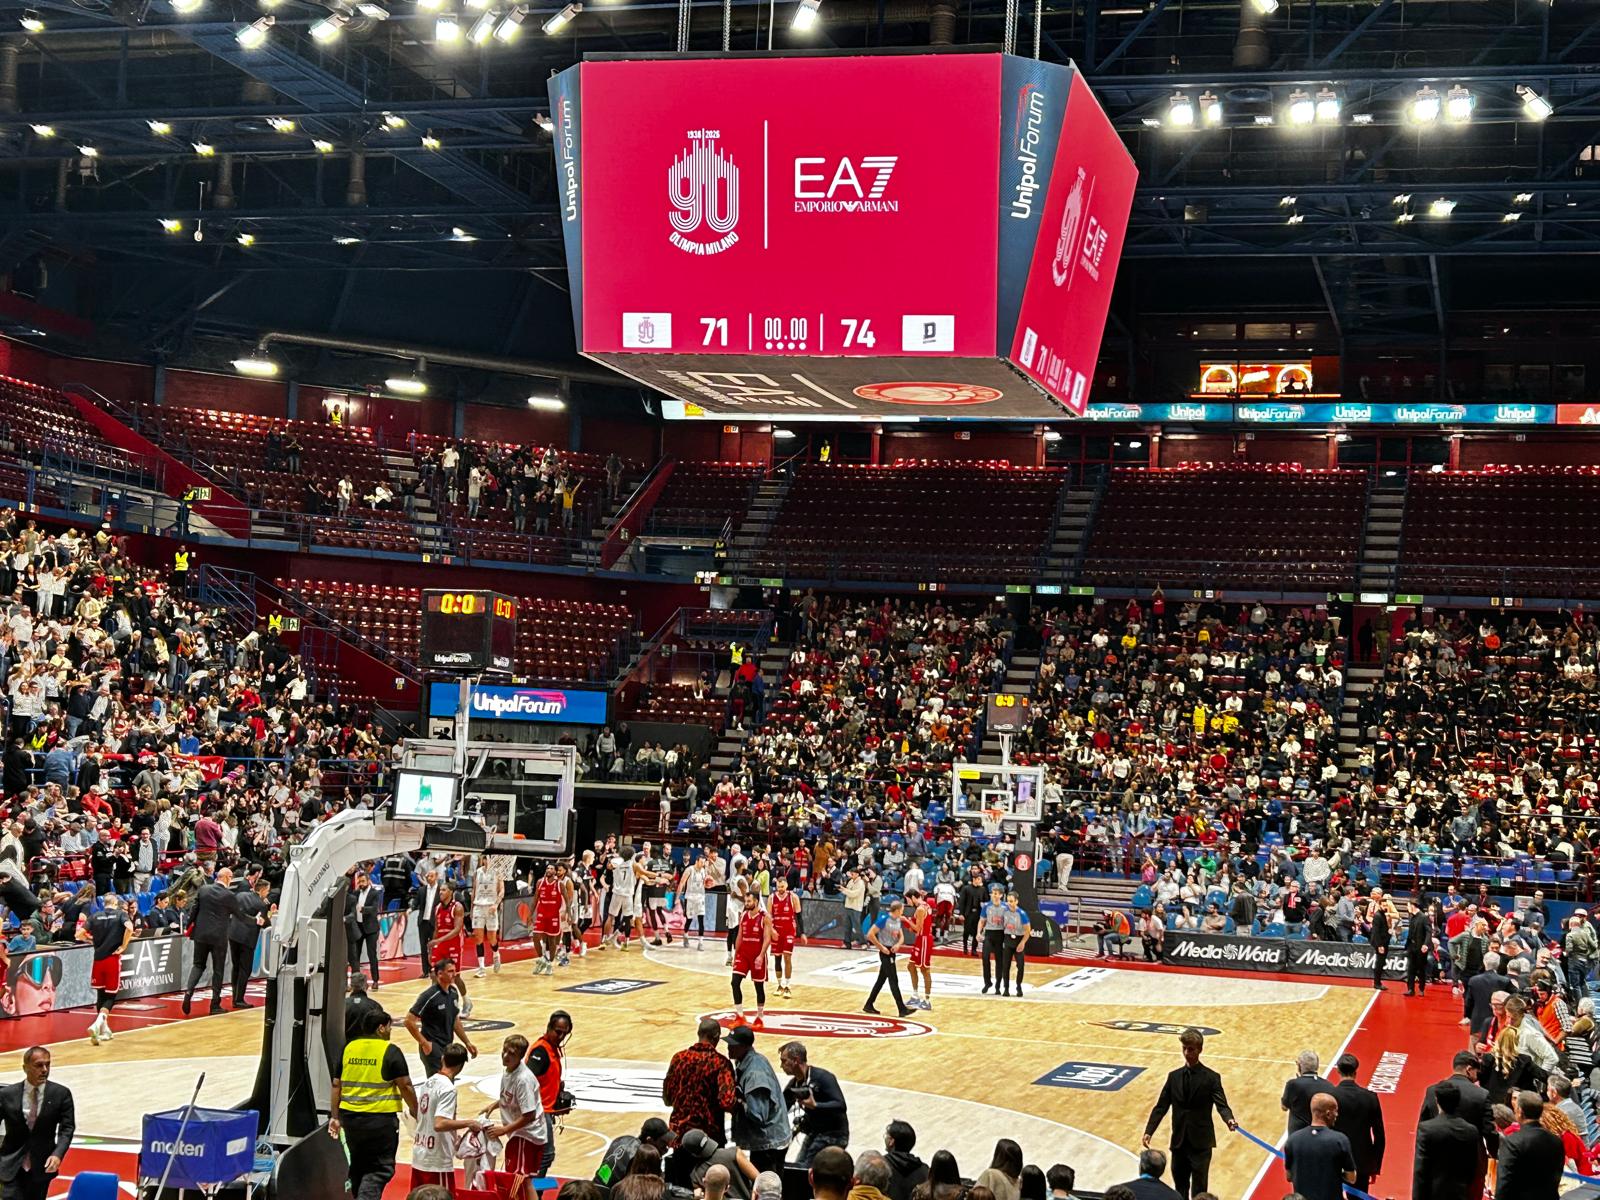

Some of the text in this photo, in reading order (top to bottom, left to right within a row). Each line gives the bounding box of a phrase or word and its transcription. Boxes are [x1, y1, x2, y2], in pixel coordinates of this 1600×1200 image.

[563, 100, 579, 221] UnipolForum
[1011, 91, 1044, 220] UnipolForum
[794, 156, 899, 199] EA7
[794, 200, 899, 212] EMPORIO ARMANI
[668, 231, 740, 256] OLIMPIA MILANO
[700, 317, 728, 346] 71
[764, 317, 808, 341] 00.00
[840, 318, 876, 348] 74
[1083, 405, 1139, 421] nipolForum
[1171, 403, 1206, 420] Unipol
[1238, 406, 1302, 420] UnipolForum
[1335, 405, 1372, 420] Unipol
[1397, 407, 1463, 421] UnipolForum
[1498, 406, 1536, 421] Unipol
[473, 691, 561, 717] UnipolForum
[1171, 940, 1281, 963] Media World
[1296, 949, 1349, 968] Media
